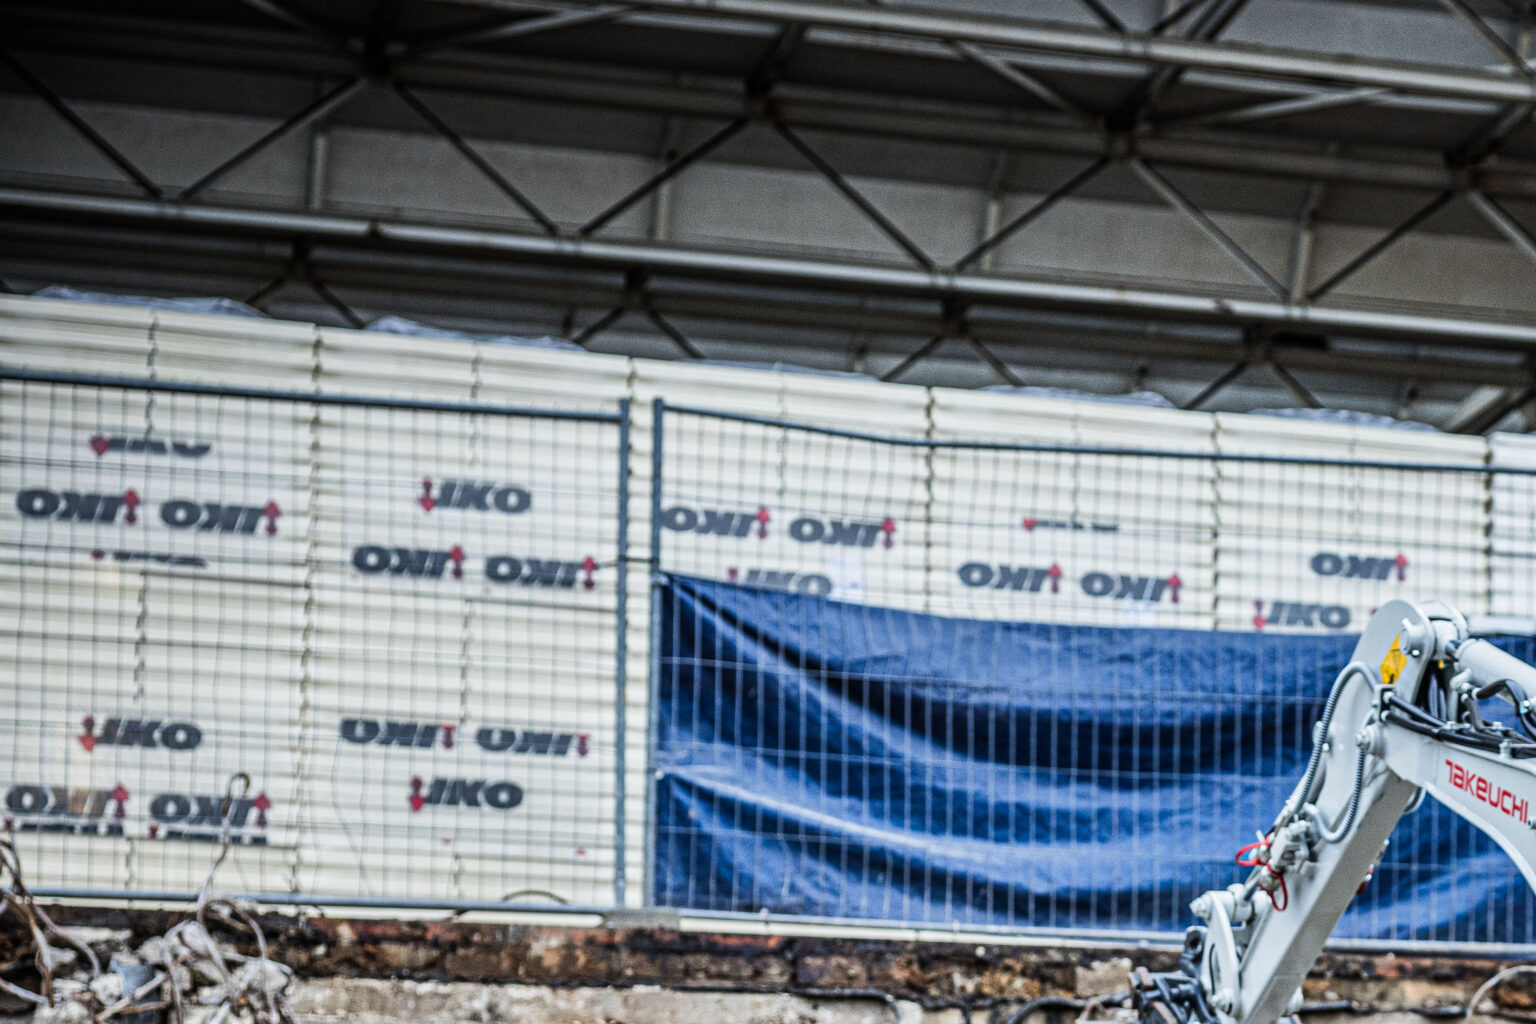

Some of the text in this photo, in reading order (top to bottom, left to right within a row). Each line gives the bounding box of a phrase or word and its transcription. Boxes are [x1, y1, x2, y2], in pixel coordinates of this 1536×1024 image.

[17, 489, 266, 533] IKO IKO
[436, 478, 532, 513] IKO
[664, 506, 882, 547] IKO IKO
[353, 545, 583, 587] IKO IKO
[958, 562, 1169, 602] IKO IKO
[1311, 553, 1396, 580] IKO
[1267, 602, 1351, 628] IKO
[97, 718, 201, 750] IKO
[425, 777, 522, 809] IKO
[1445, 759, 1529, 824] TAKEUCHI
